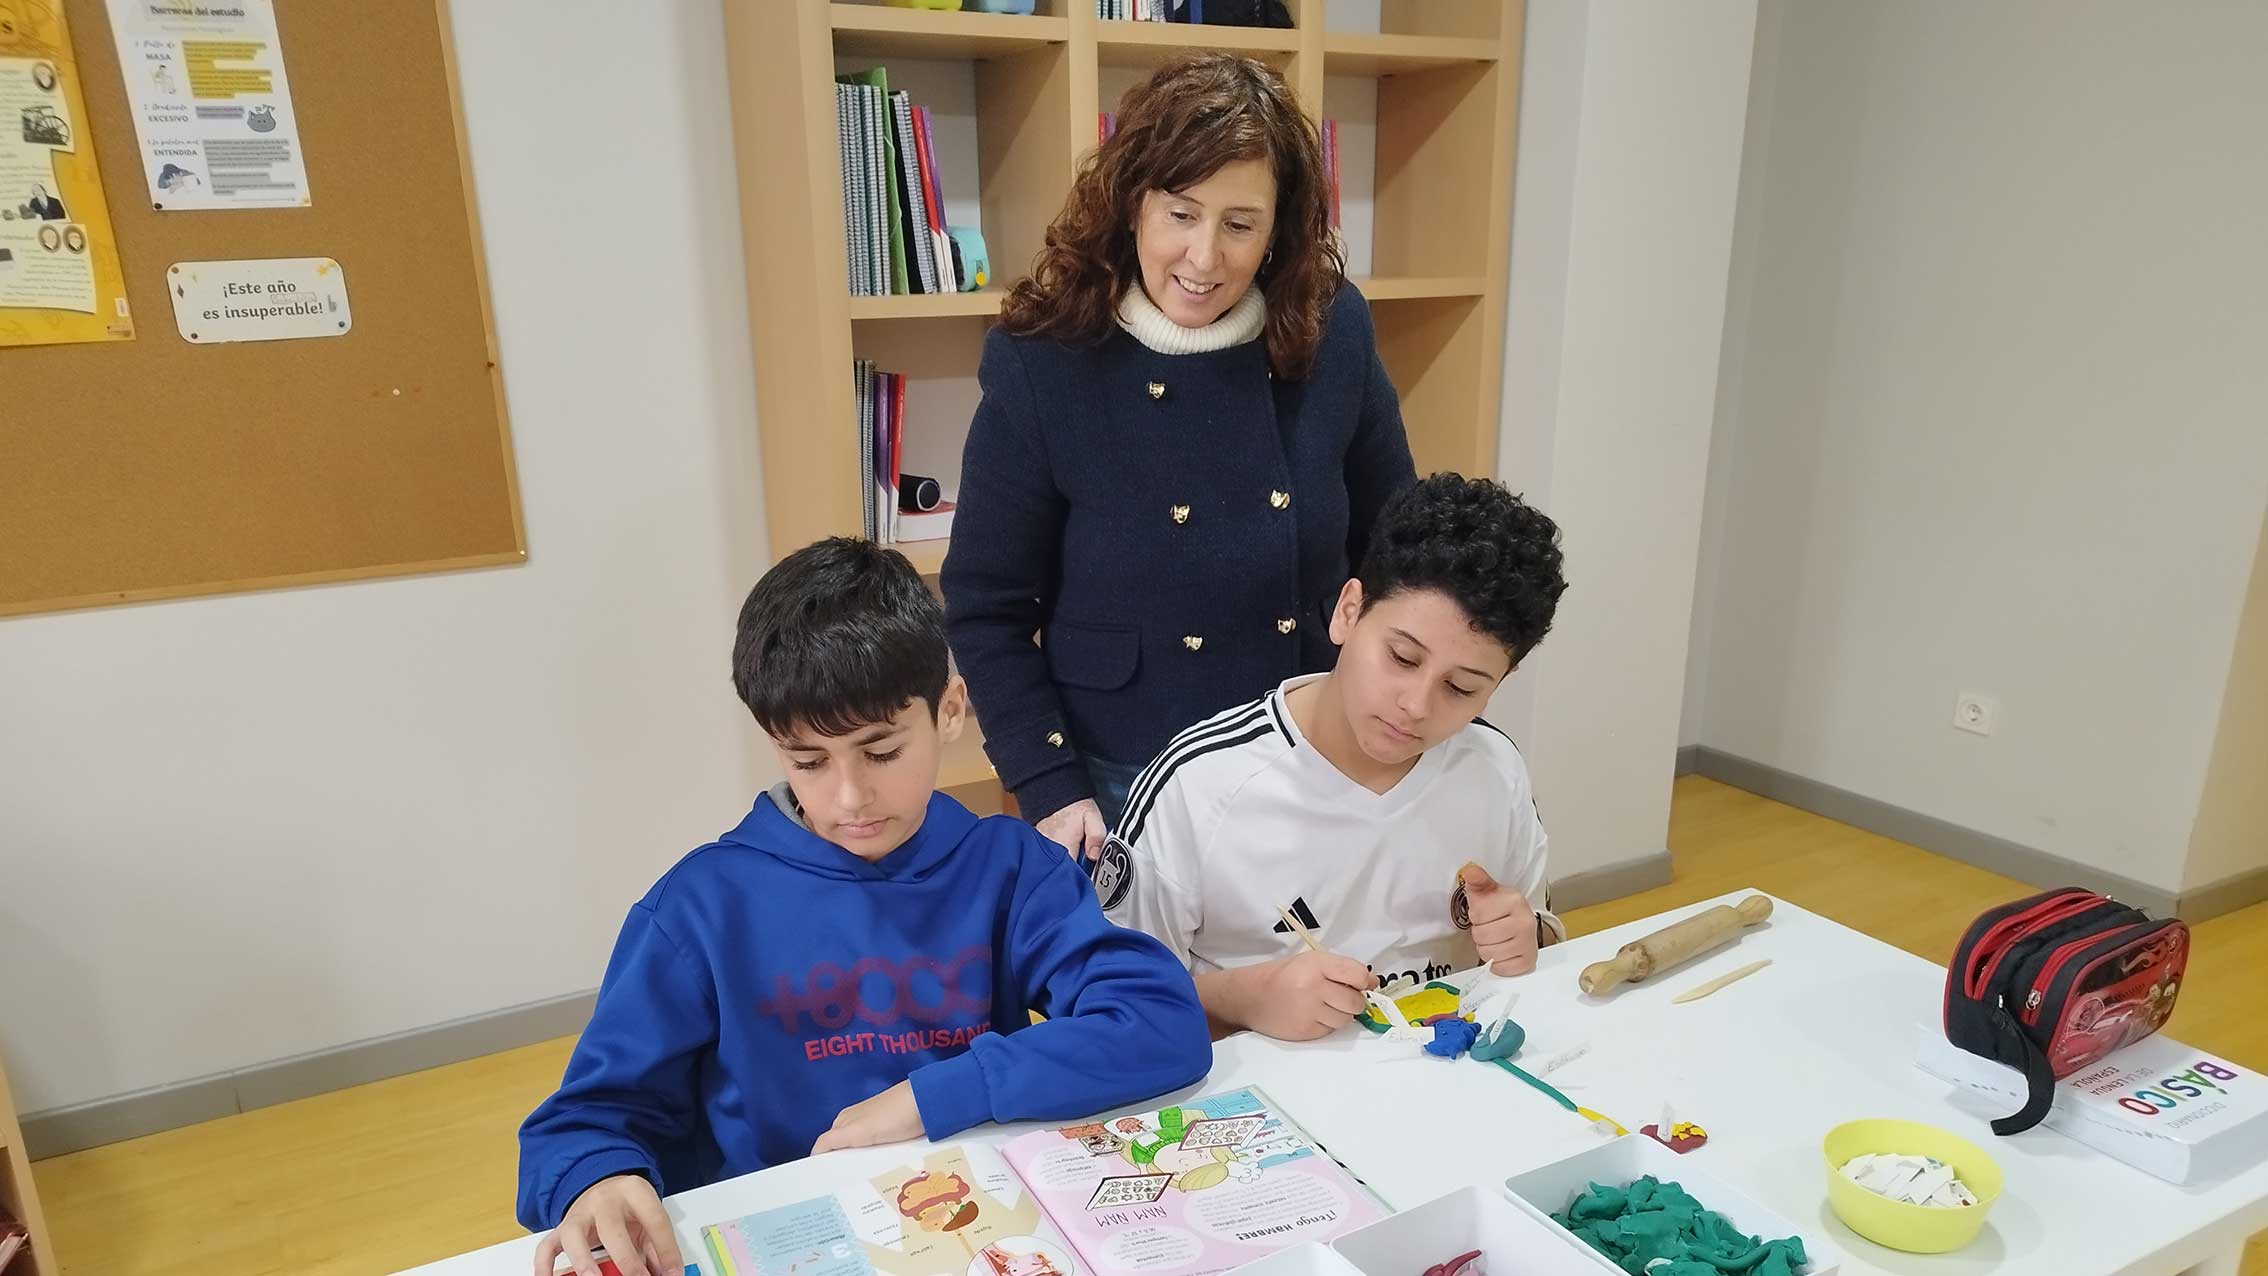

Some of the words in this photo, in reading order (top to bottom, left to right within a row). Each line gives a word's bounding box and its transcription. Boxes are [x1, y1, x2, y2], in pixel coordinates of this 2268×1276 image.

[195, 7, 209, 16] del
[211, 8, 245, 17] estudio
[146, 53, 172, 61] MASA
[224, 282, 262, 298] ¡Este
[267, 280, 296, 293] año
[203, 309, 220, 319] es
[225, 302, 323, 320] insuperable!
[804, 1032, 875, 1061] EIGHT
[2072, 1066, 2120, 1089] ESPAÑOLA
[2089, 1077, 2126, 1096] LENGUA
[2118, 1061, 2239, 1116] BÁSICO
[1295, 1209, 1338, 1227] ¡Tengo
